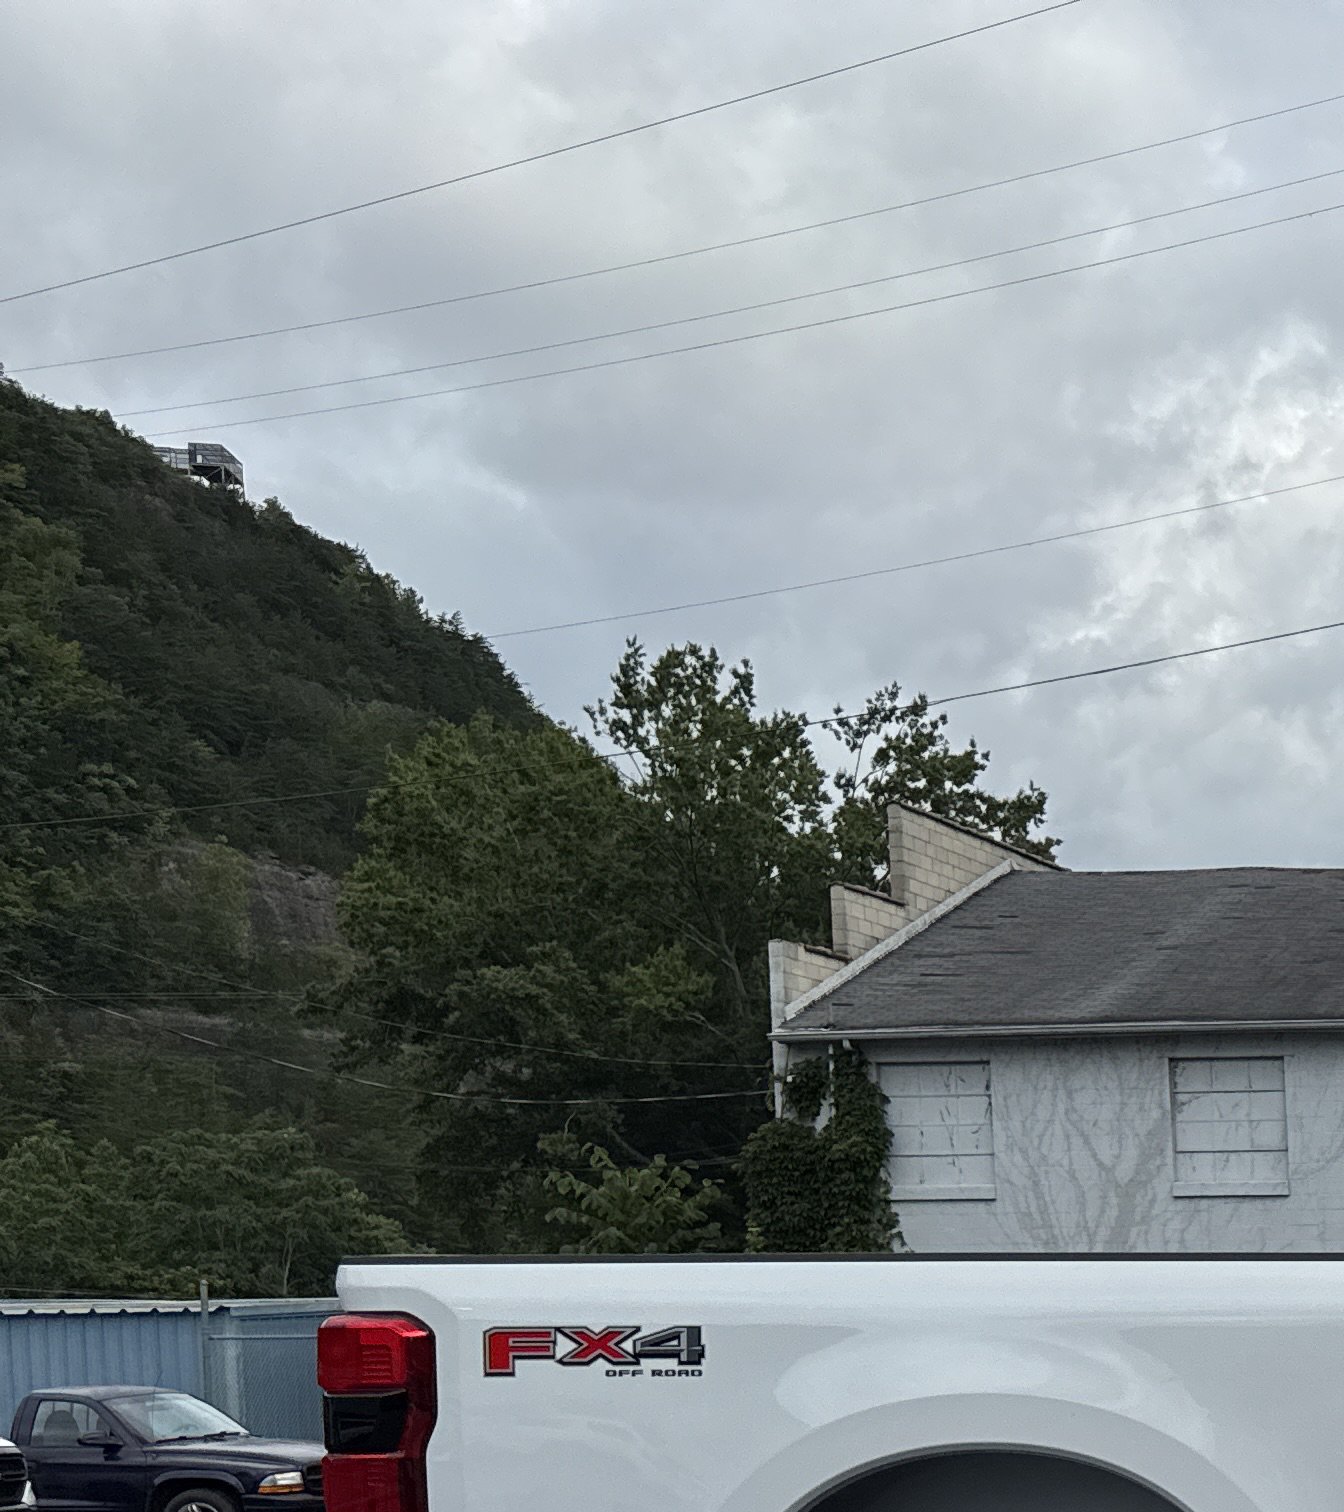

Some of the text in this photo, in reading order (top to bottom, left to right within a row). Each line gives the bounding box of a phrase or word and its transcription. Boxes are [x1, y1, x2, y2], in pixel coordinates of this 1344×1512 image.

[483, 1326, 705, 1377] FX4
[605, 1369, 703, 1377] OFF ROAD
